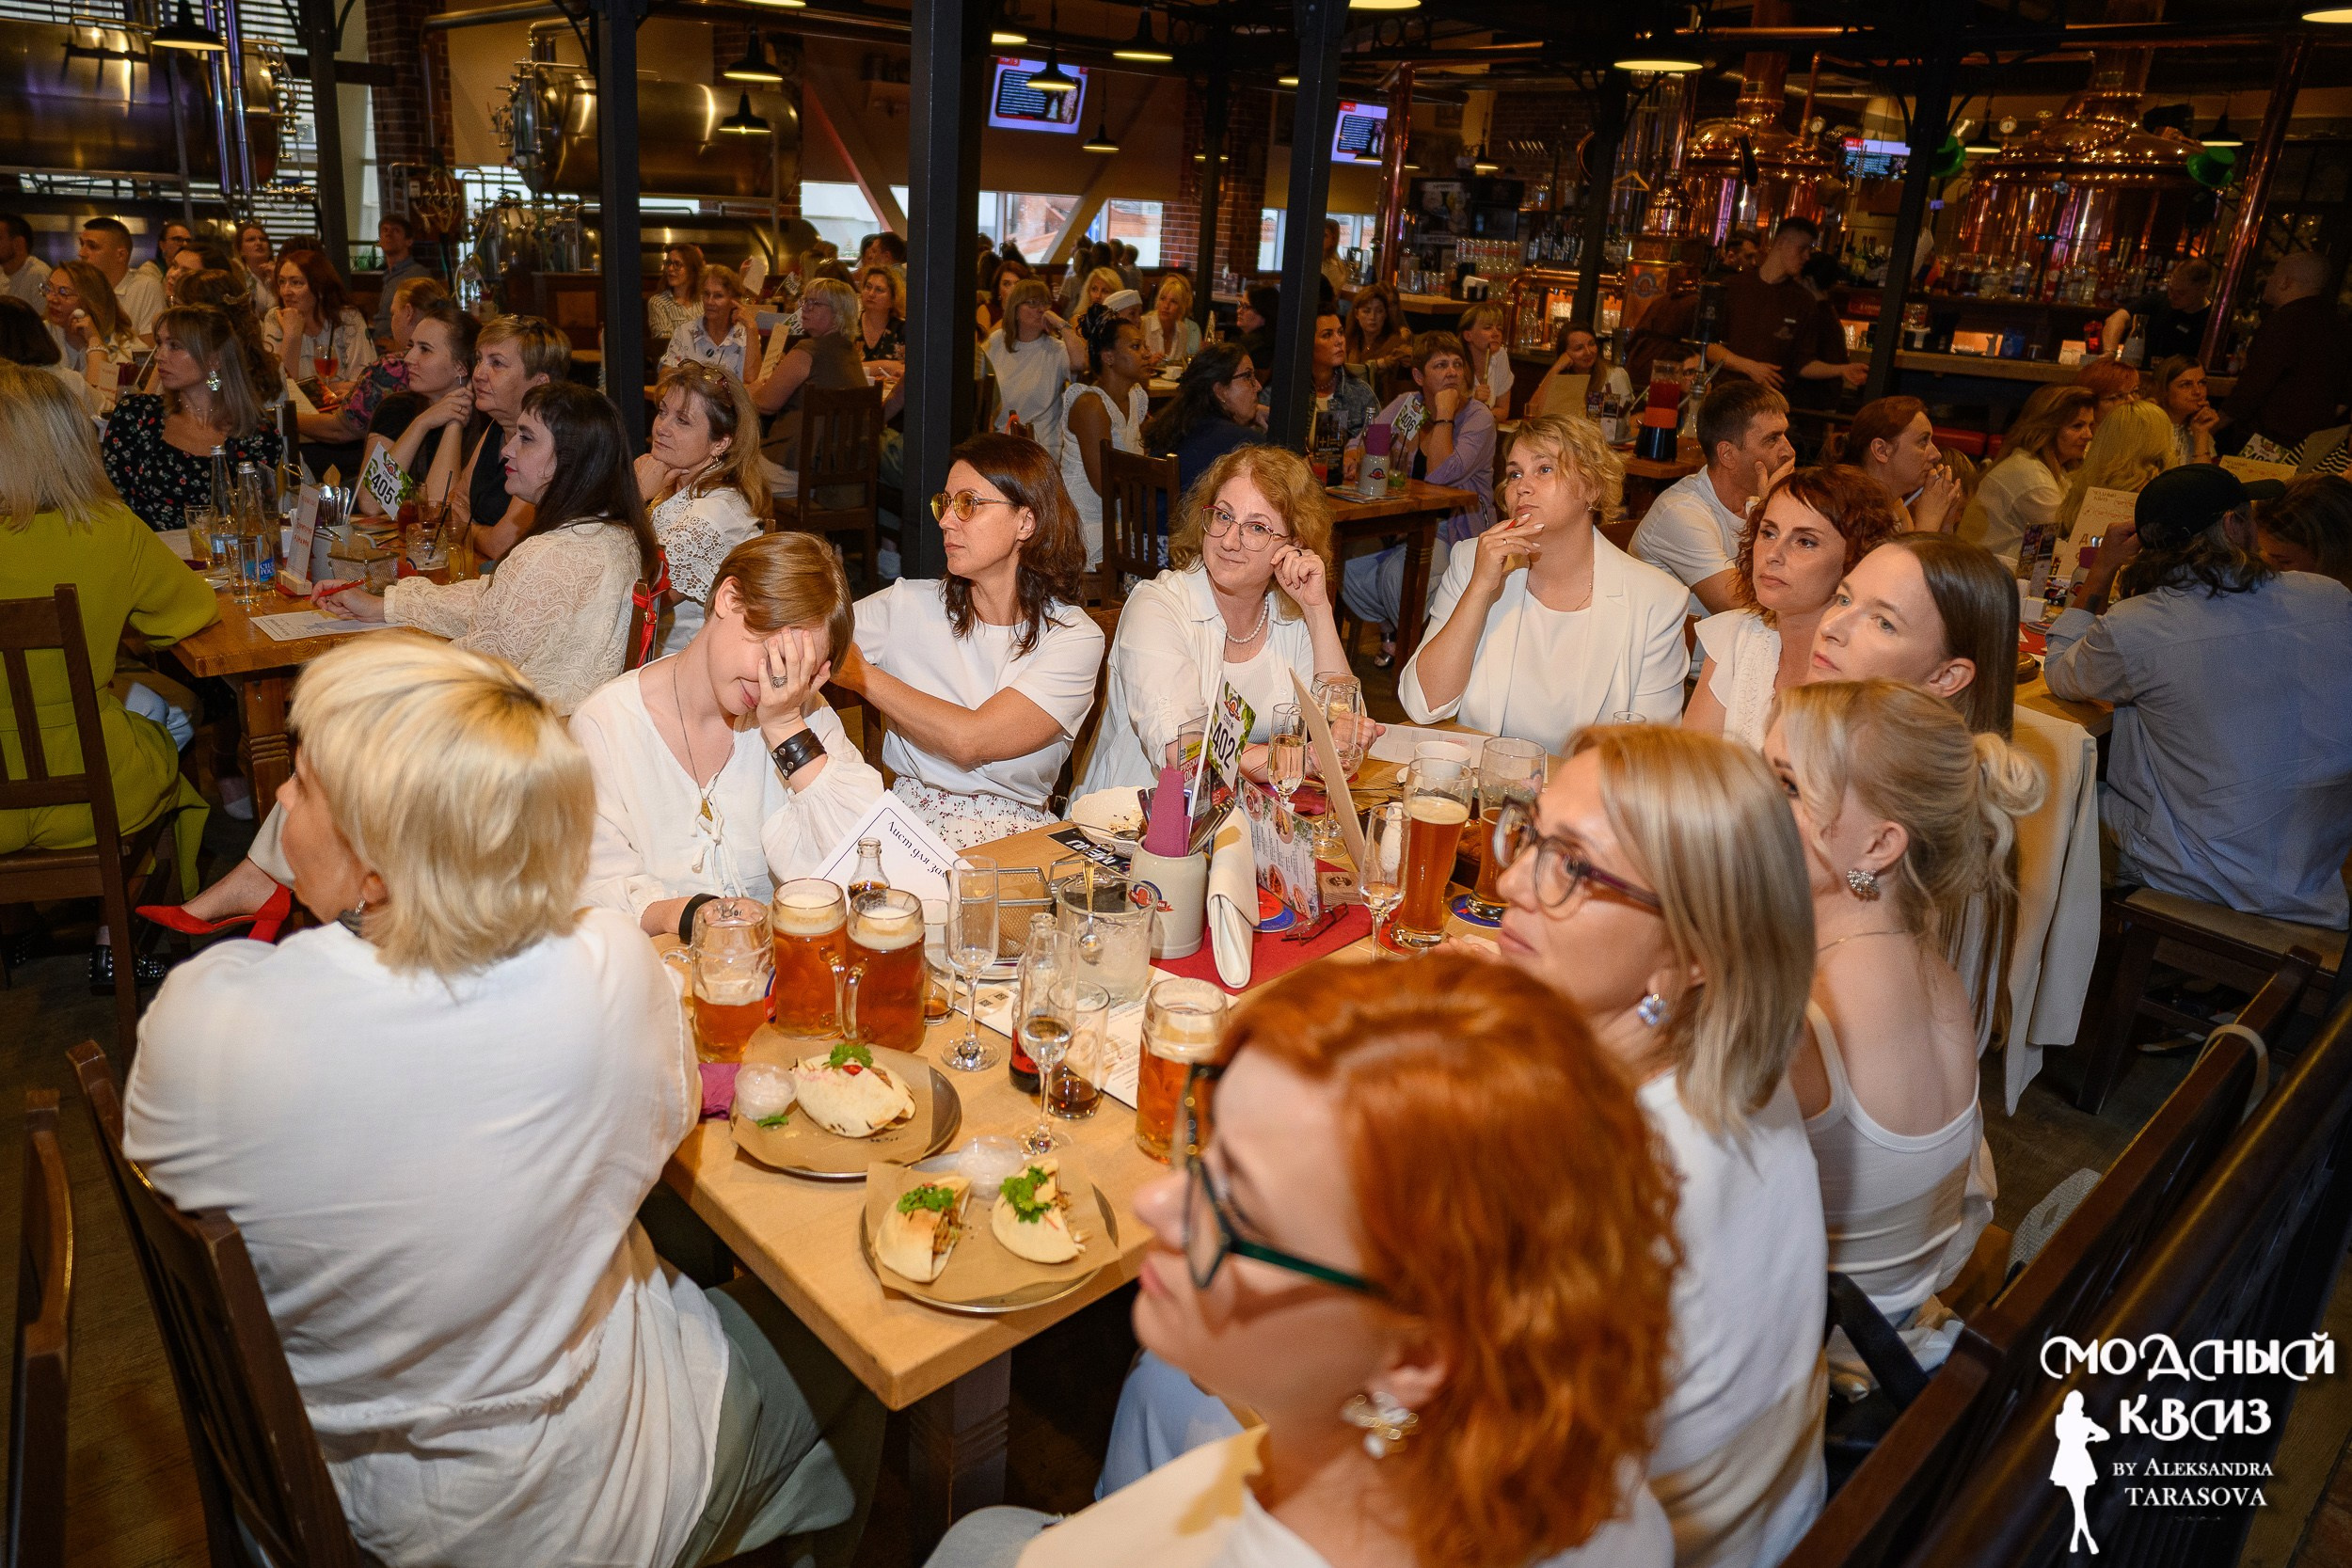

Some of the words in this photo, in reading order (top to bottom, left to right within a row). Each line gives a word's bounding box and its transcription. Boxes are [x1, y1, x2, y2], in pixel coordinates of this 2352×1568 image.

[1400, 414, 1416, 432] 406
[372, 473, 395, 505] 405
[1213, 721, 1236, 770] 402
[1180, 754, 1201, 772] РУССКИ
[888, 821, 913, 848] Лист
[910, 848, 930, 864] для
